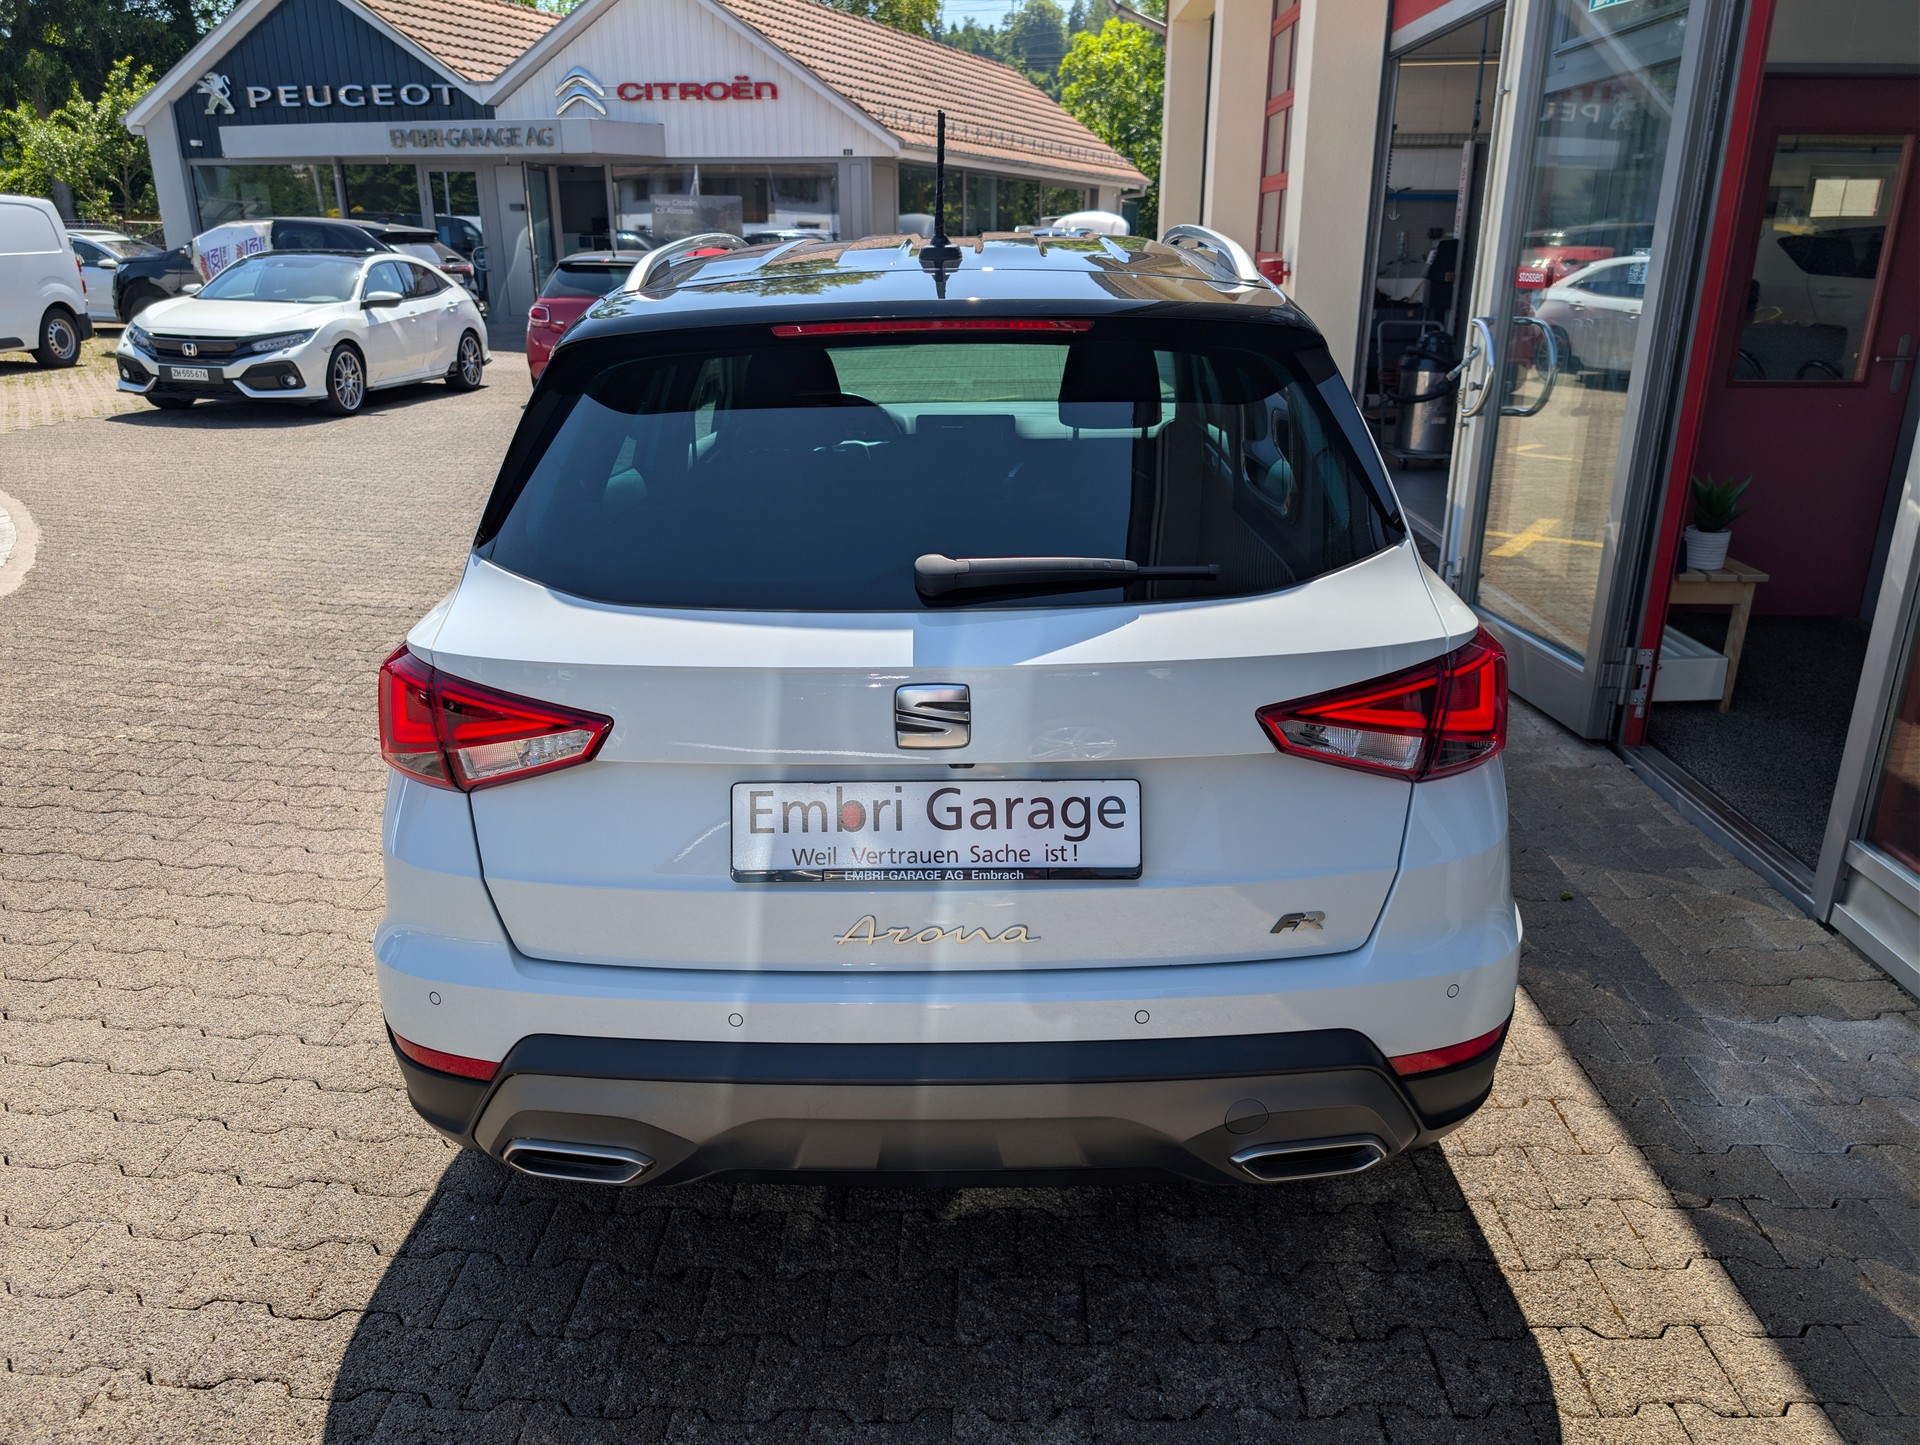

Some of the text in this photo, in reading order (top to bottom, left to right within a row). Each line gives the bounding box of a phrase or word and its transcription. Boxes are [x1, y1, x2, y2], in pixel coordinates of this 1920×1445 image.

[246, 83, 456, 108] PEUGEOT
[389, 126, 555, 148] EMBRI-GARAGE AG
[666, 207, 694, 215] Aircross
[1518, 271, 1544, 283] stossen
[749, 785, 1127, 842] Embri Garage
[791, 846, 837, 866] Weil
[851, 846, 959, 866] Vertrauen
[970, 843, 1031, 864] Sache
[844, 869, 1024, 881] EMBRI-GARAGE AG Embrach
[833, 914, 1042, 945] Arona
[1269, 910, 1326, 935] FR
